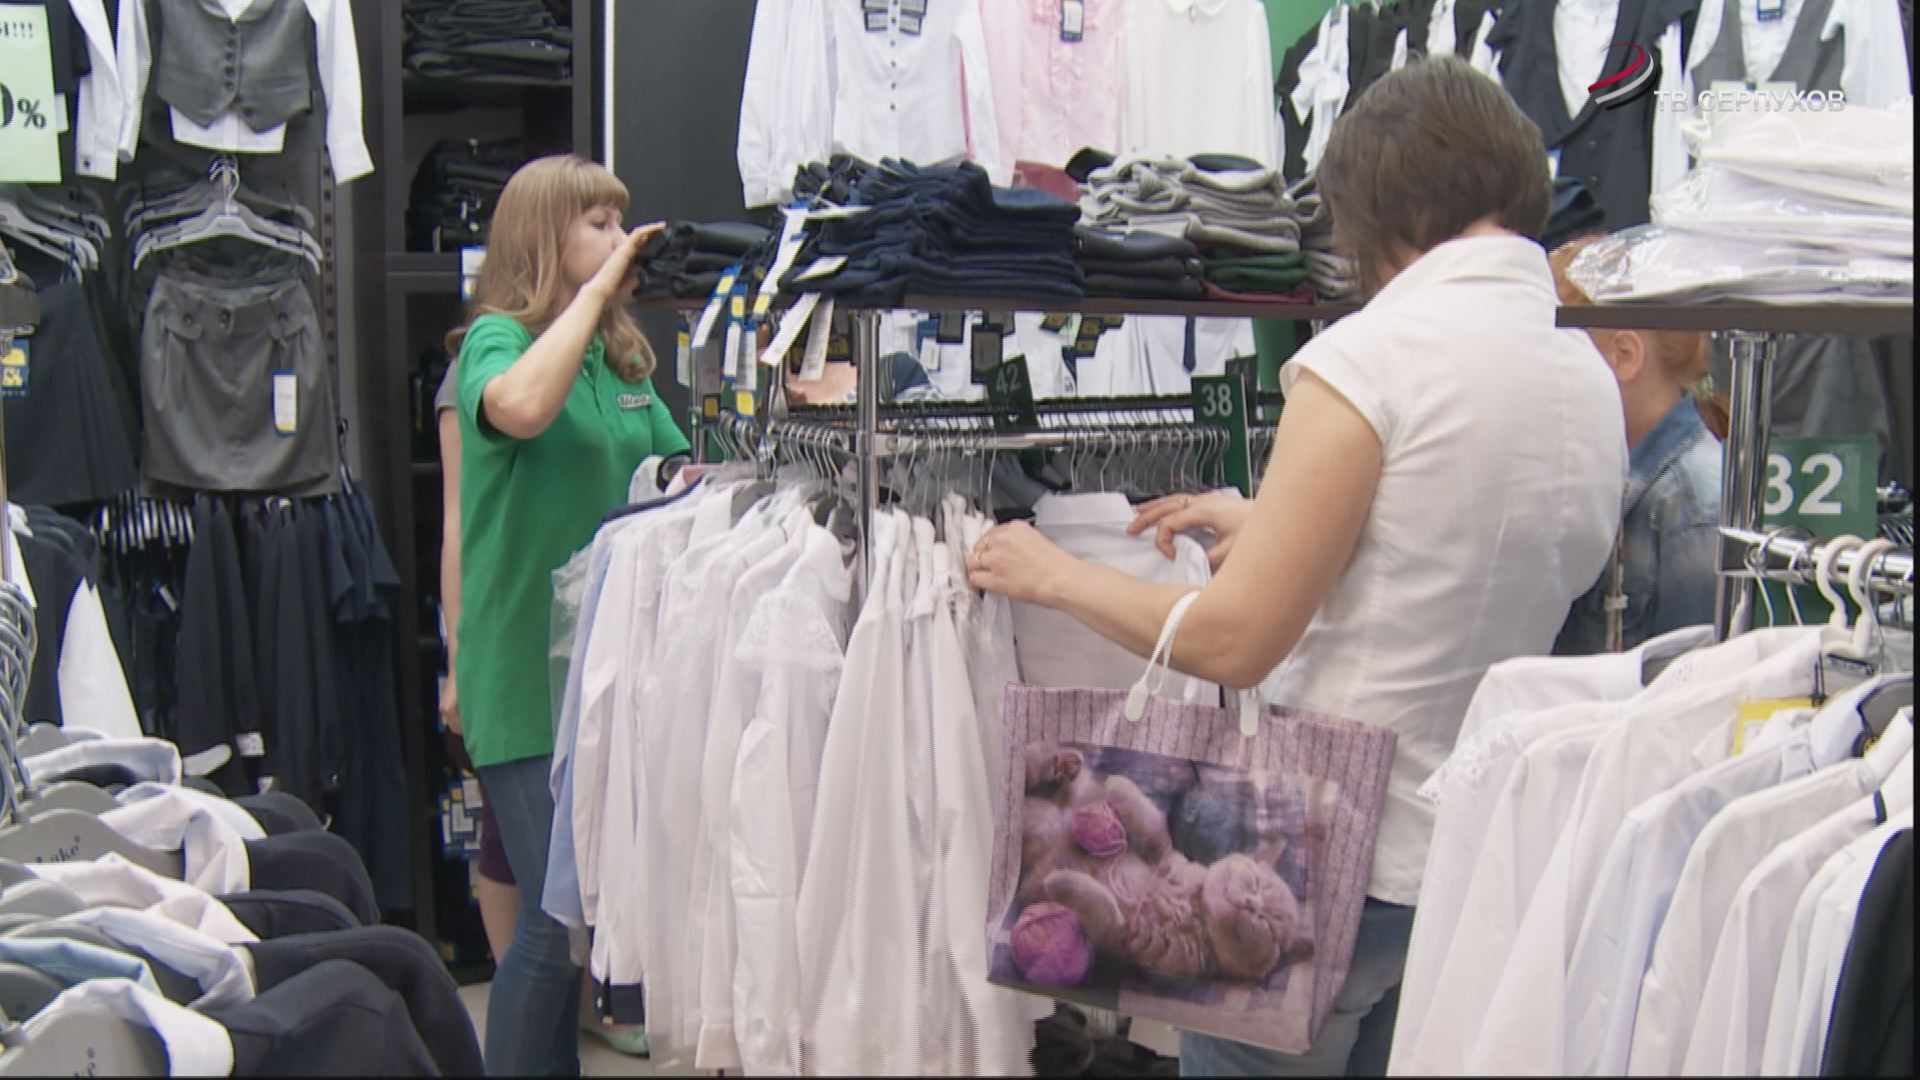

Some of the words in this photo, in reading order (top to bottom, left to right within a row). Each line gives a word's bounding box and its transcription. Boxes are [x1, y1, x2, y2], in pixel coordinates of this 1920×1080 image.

[996, 364, 1021, 394] 42
[1201, 383, 1232, 416] 38
[1764, 452, 1843, 516] 32
